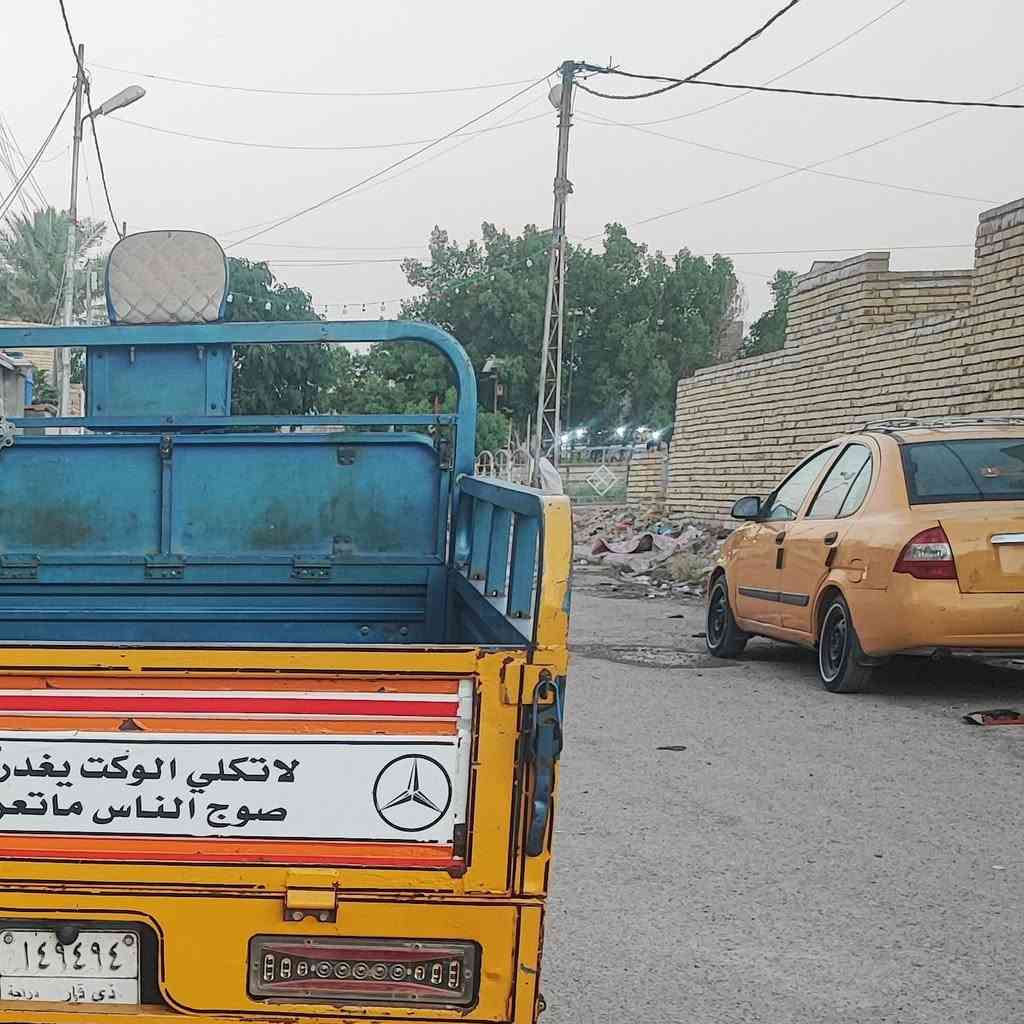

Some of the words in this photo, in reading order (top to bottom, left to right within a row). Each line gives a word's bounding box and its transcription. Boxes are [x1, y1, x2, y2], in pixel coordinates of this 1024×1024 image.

[92, 795, 195, 824] الناس
[206, 801, 288, 828] صوج
[23, 941, 123, 970] ١٤٩٤٩٤
